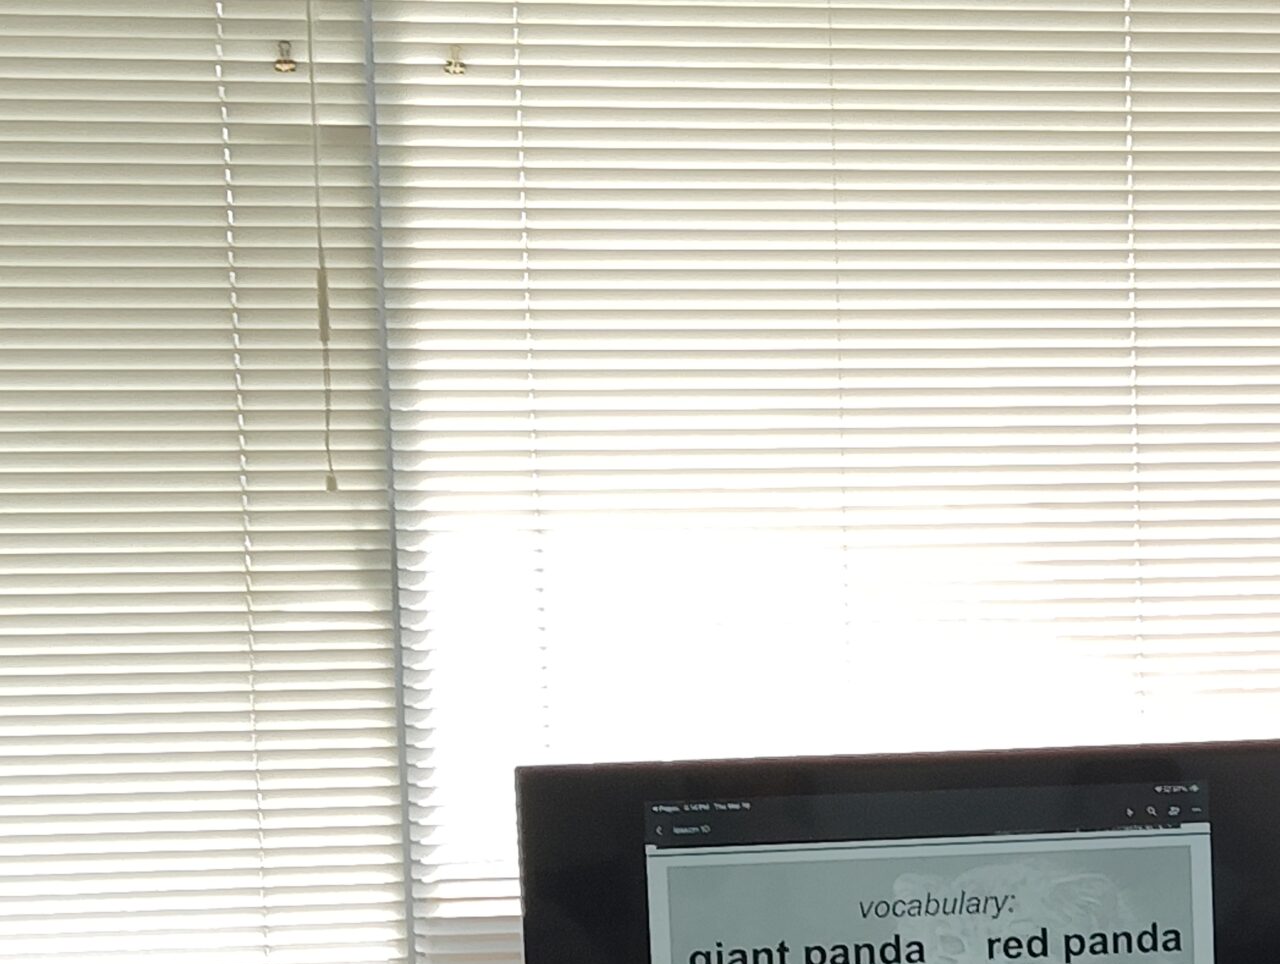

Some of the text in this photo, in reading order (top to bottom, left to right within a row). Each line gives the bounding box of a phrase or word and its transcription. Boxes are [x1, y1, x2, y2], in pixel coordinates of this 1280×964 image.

[859, 889, 1016, 920] vocabulary:
[987, 921, 1183, 964] red panda
